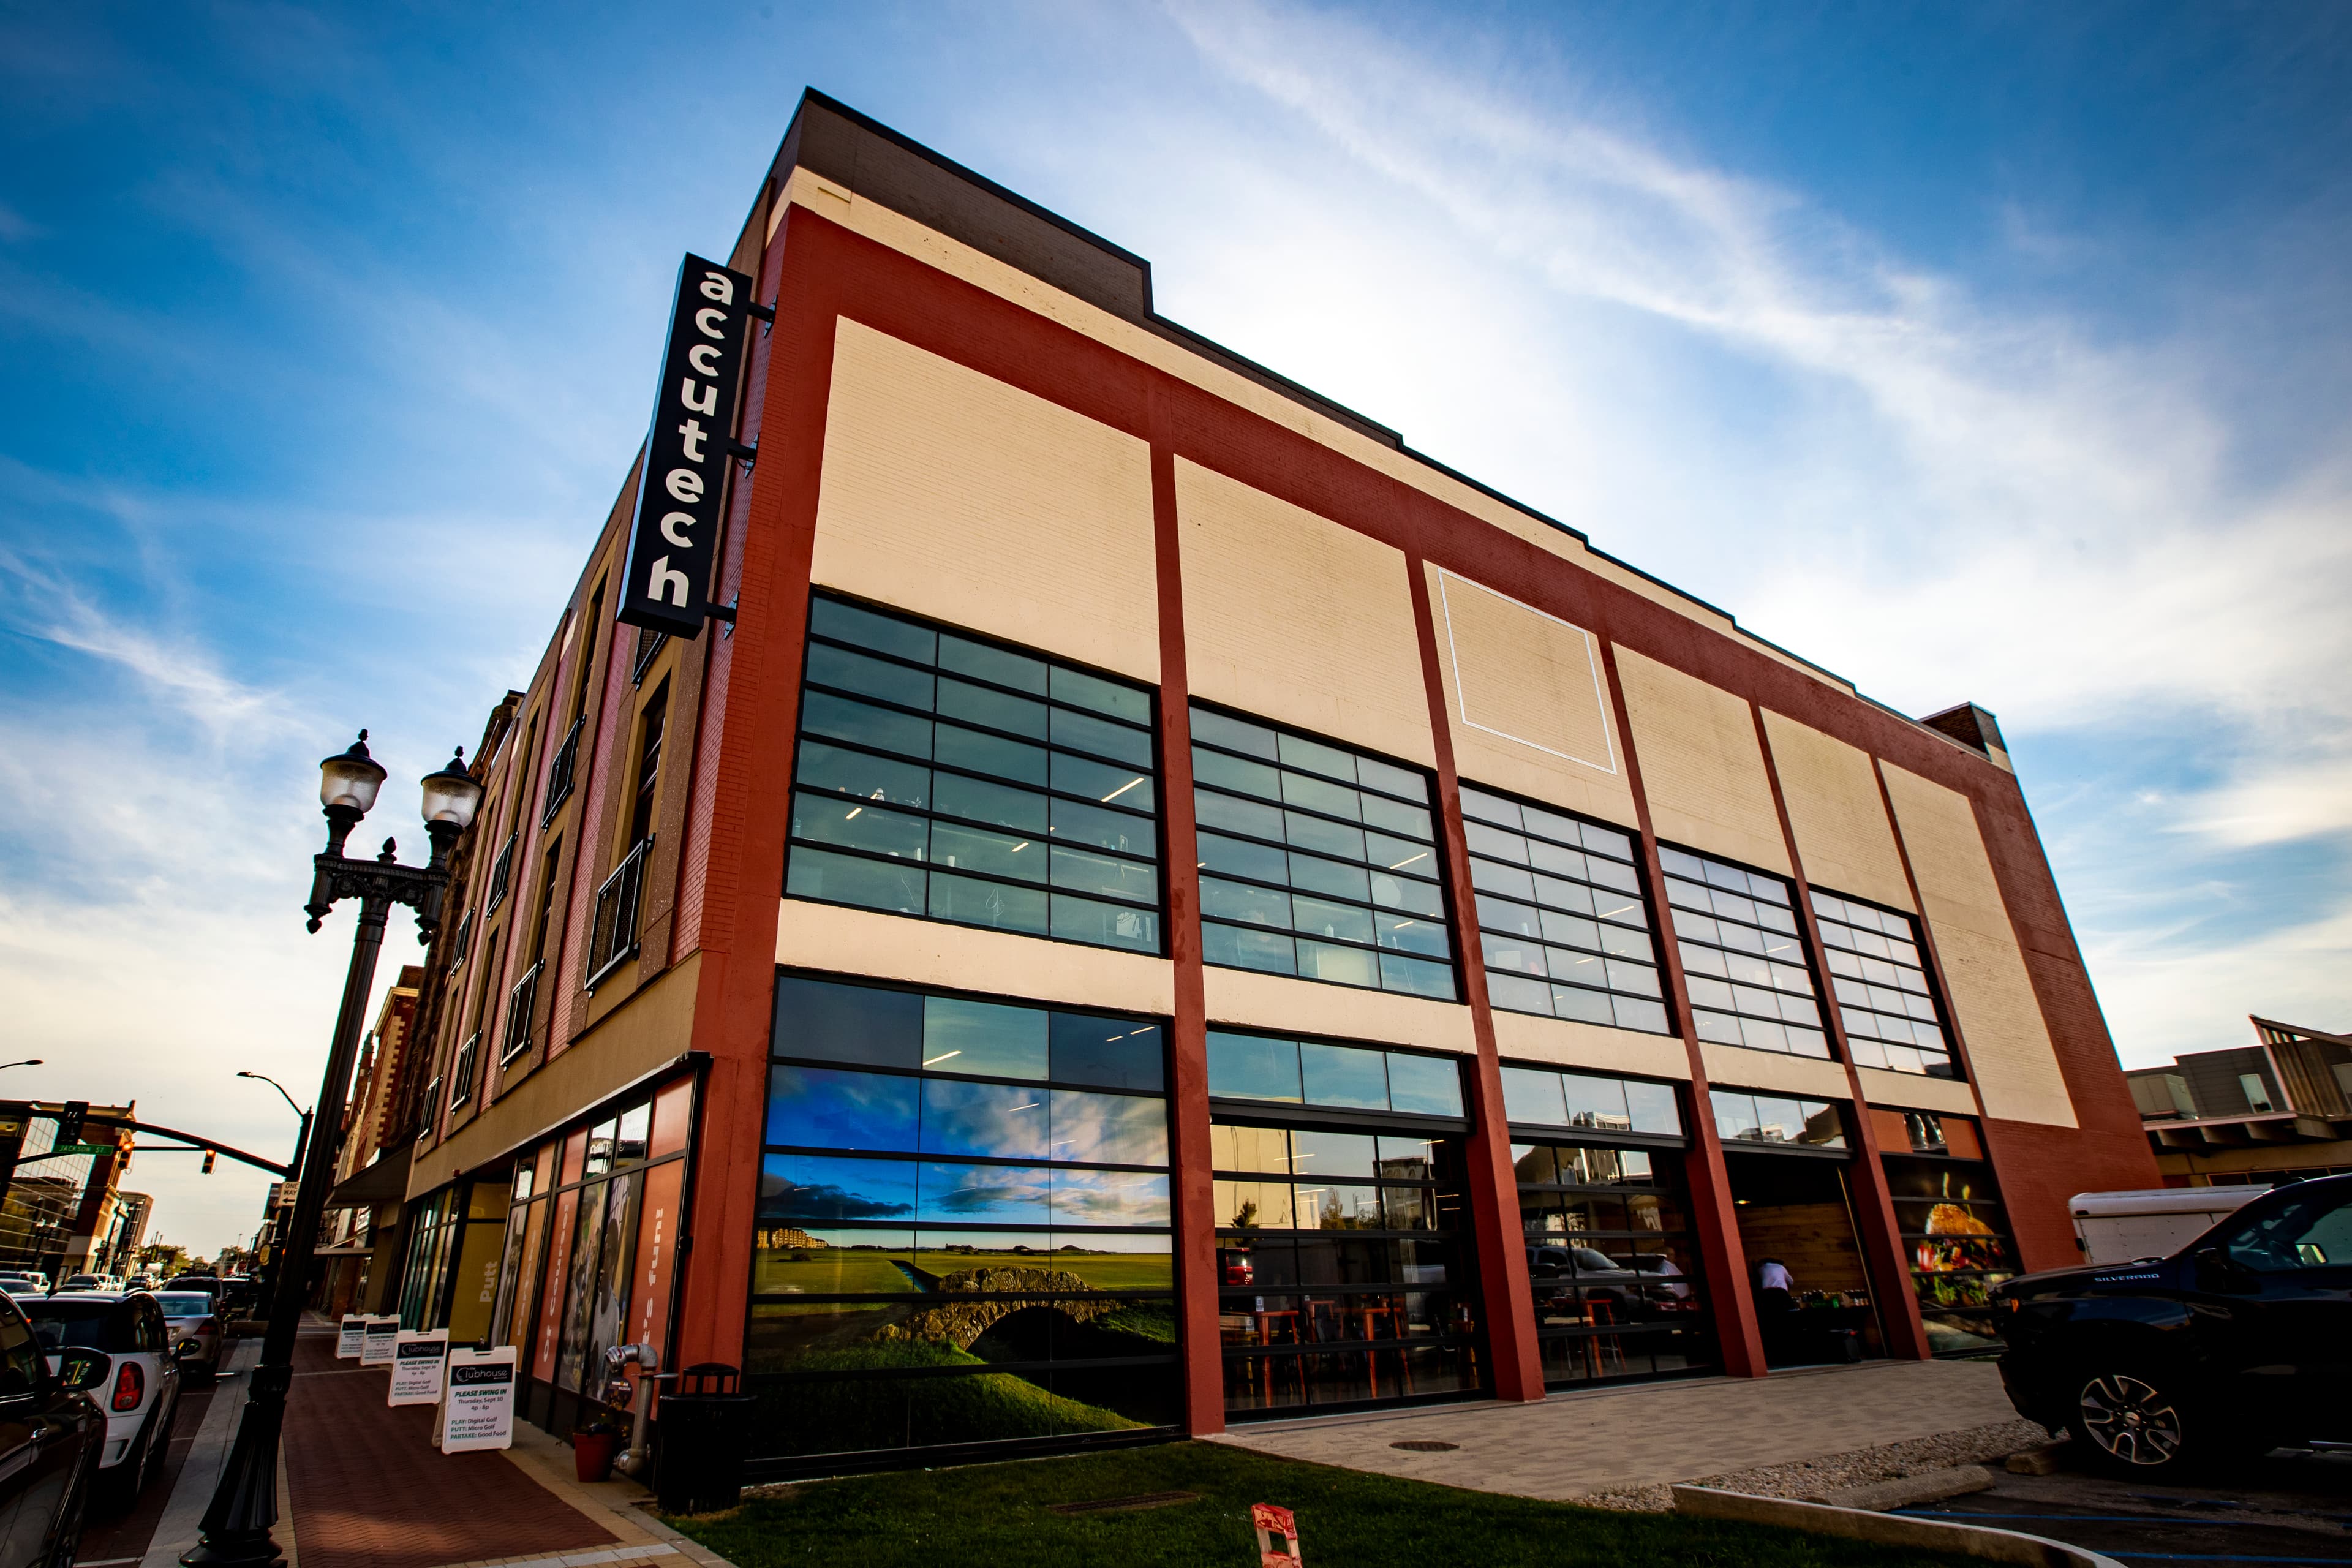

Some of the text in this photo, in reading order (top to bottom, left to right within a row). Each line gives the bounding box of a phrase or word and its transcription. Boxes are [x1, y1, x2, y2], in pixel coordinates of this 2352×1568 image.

[647, 271, 734, 608] accutech
[648, 1208, 664, 1287] fun!
[480, 1261, 497, 1303] Putt
[2094, 1273, 2160, 1282] SILVERADO
[402, 1344, 440, 1355] Clubhouse
[543, 1325, 551, 1363] Of
[456, 1367, 508, 1382] Clubhouse
